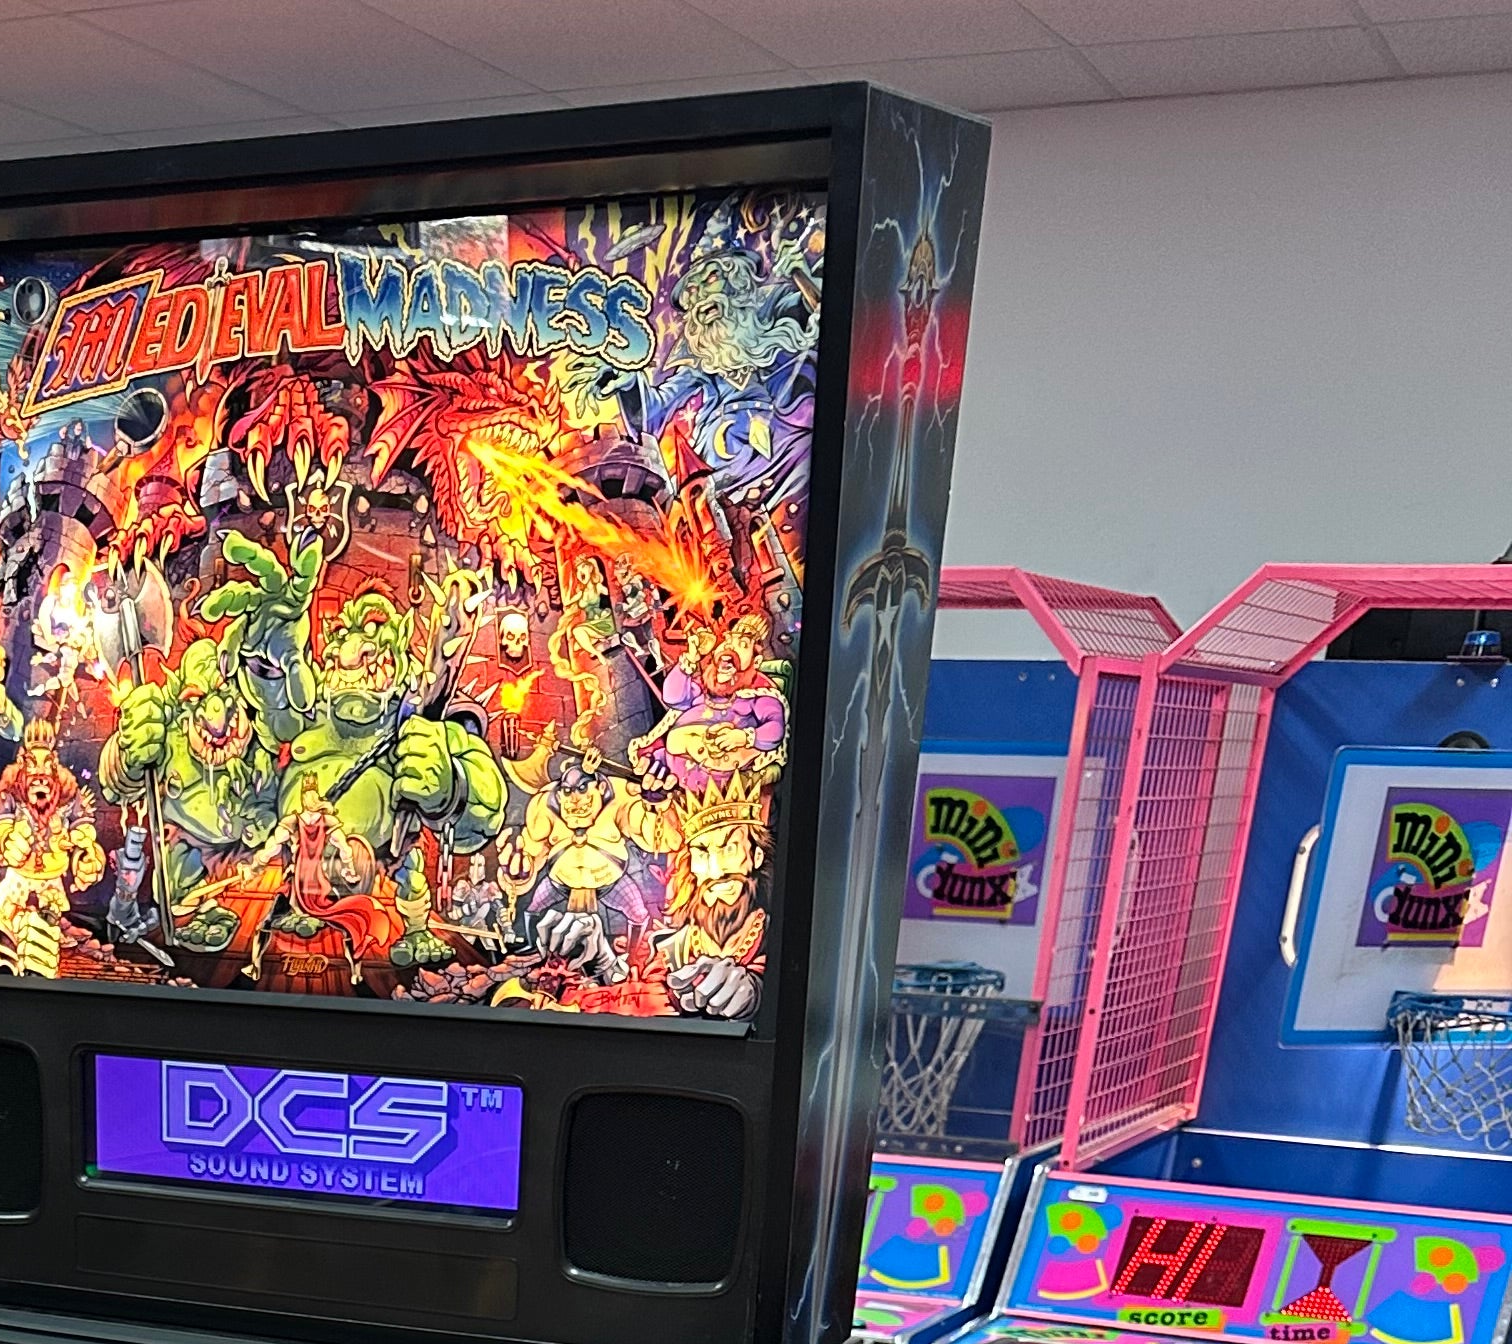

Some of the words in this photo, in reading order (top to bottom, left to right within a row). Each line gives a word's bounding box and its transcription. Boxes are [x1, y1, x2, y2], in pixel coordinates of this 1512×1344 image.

[337, 250, 656, 372] MADNESS
[162, 1059, 451, 1165] DCS
[461, 1086, 503, 1112] TM
[188, 1152, 290, 1187] SOUND
[299, 1162, 425, 1197] SYSTEM
[1129, 1310, 1209, 1327] score
[1269, 1325, 1331, 1341] time
